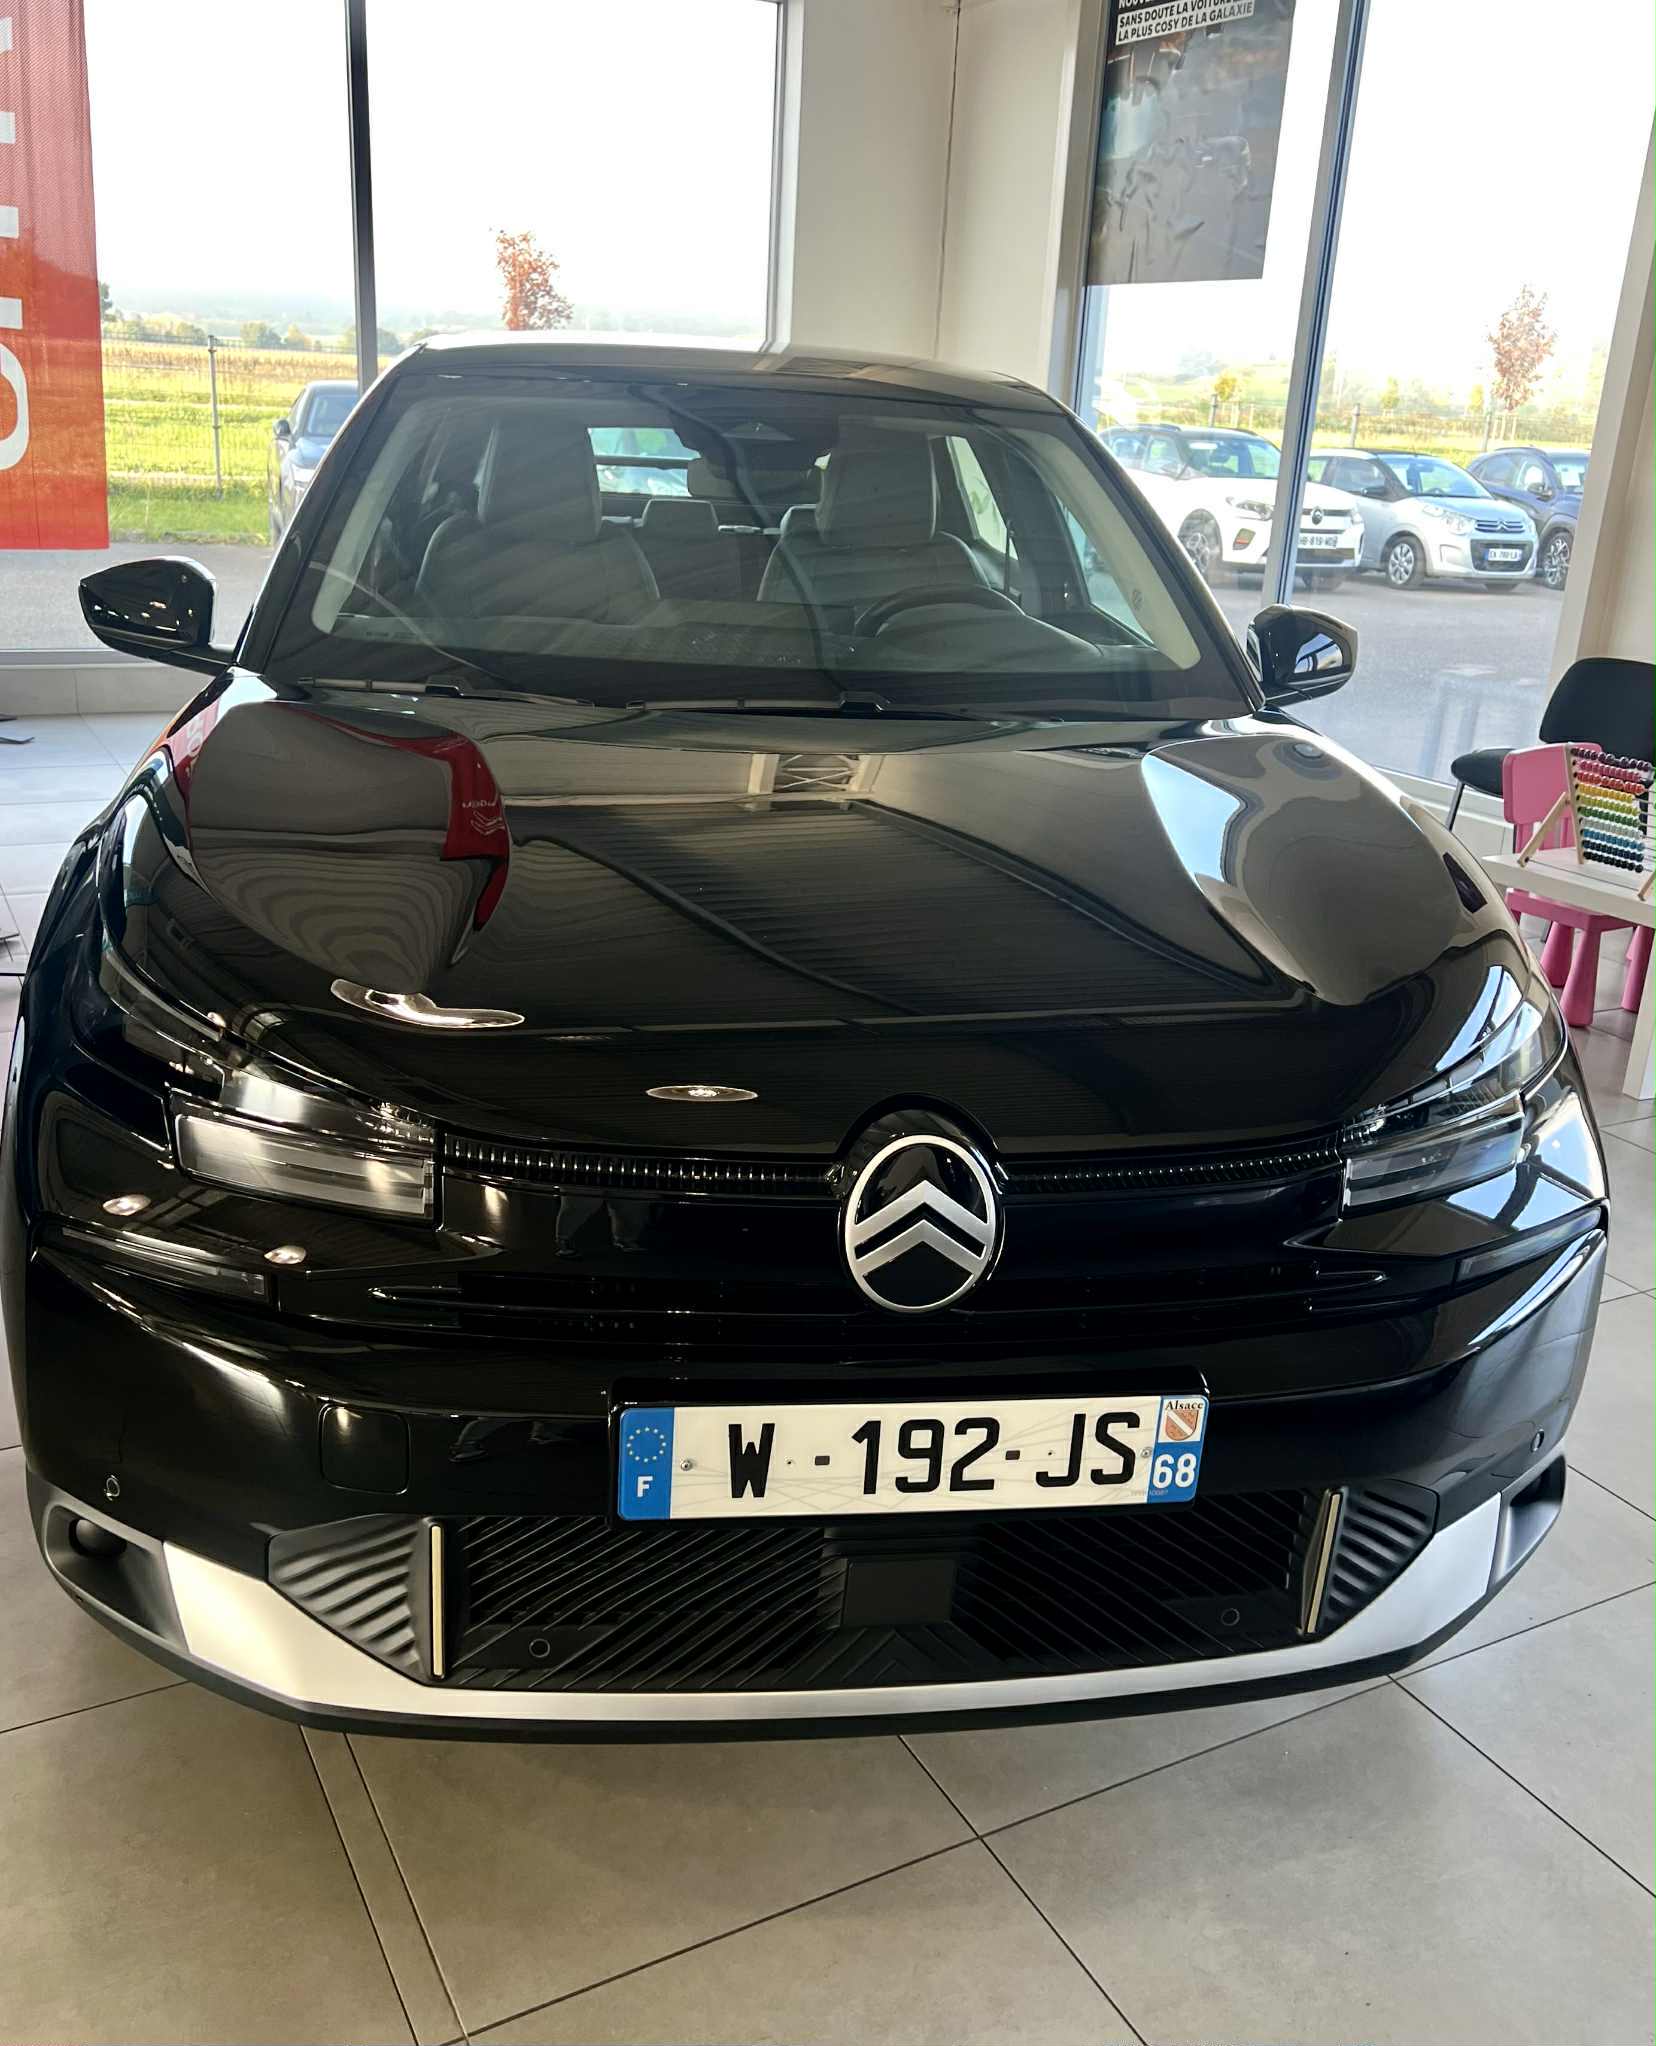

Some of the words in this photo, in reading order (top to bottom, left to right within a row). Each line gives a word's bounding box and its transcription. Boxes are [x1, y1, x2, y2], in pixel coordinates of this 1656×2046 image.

[1118, 30, 1129, 42] LA
[1131, 24, 1153, 38] PLUS
[1154, 18, 1179, 34] COSY
[1181, 15, 1193, 28] DE
[1195, 12, 1207, 25] LA
[1209, 1, 1252, 21] GALAXIE
[1120, 12, 1143, 28] SANS
[1144, 5, 1175, 22] DOUTE
[1176, 2, 1188, 15] LA
[1165, 1400, 1204, 1411] Alsace
[1152, 1453, 1197, 1489] 68
[636, 1475, 654, 1498] F
